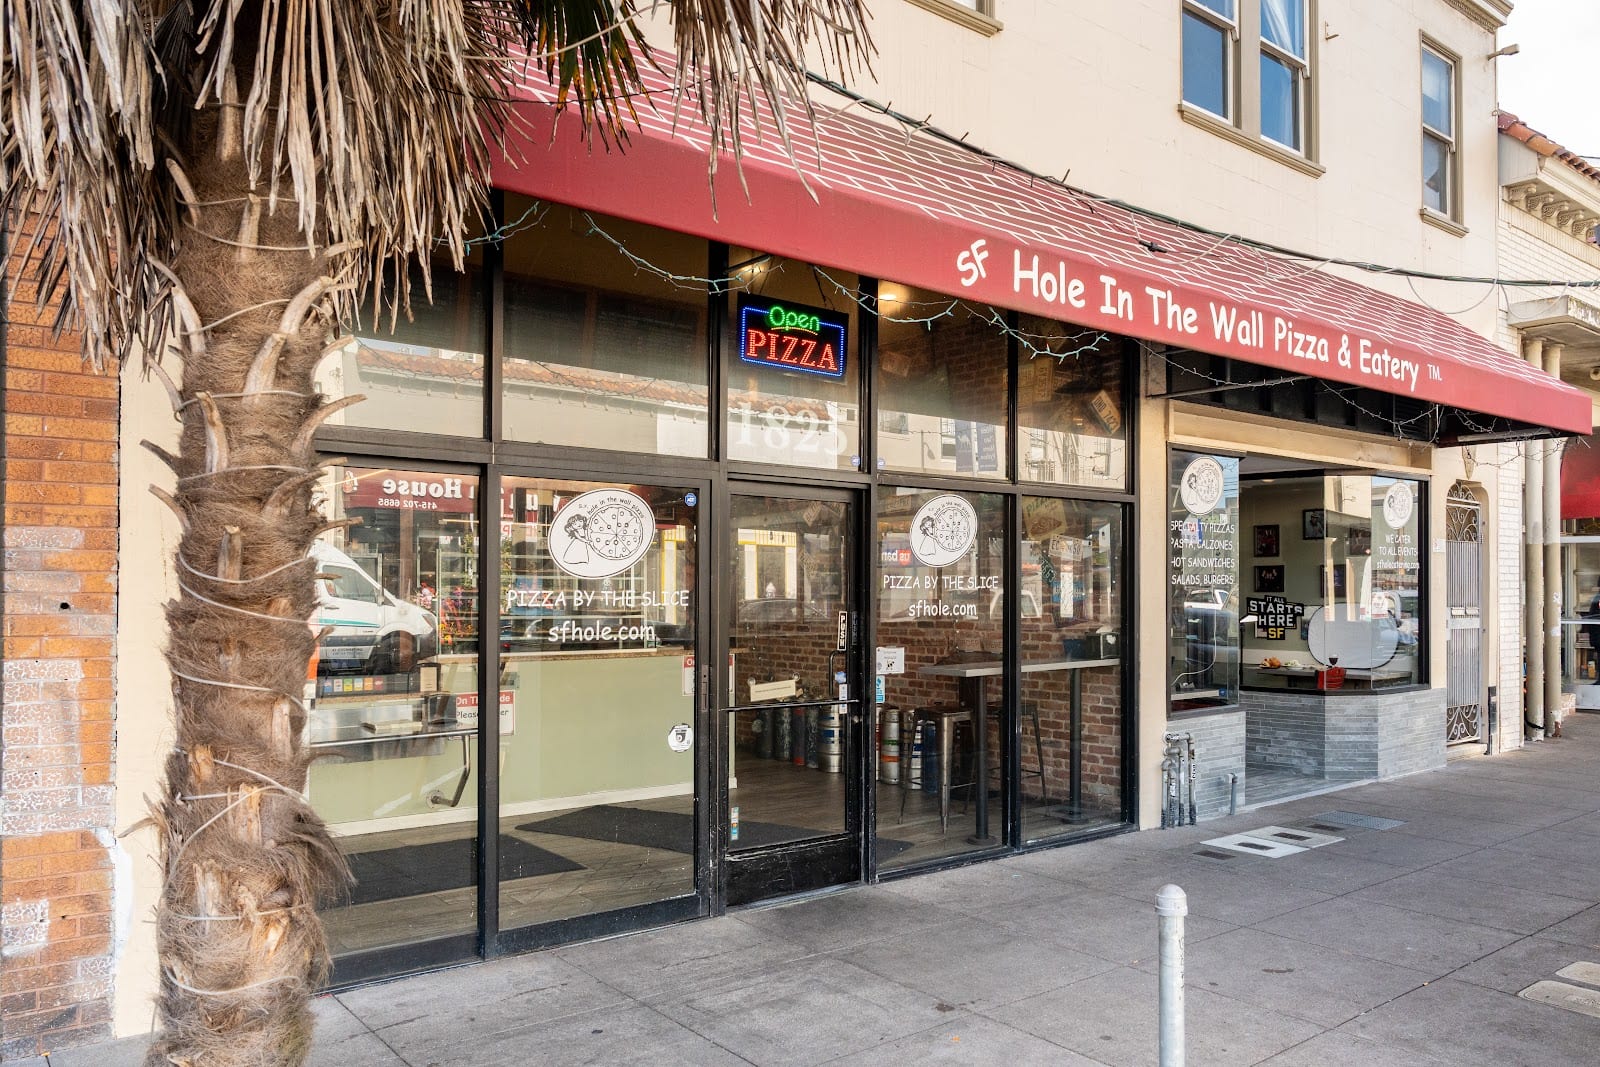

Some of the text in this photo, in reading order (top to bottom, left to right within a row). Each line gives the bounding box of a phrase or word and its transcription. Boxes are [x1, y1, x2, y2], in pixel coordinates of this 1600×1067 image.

[769, 306, 821, 331] Open
[956, 238, 989, 287] SF
[1013, 249, 1085, 308] Hole
[1099, 274, 1134, 321] In
[1145, 285, 1198, 334] The
[1210, 302, 1264, 348] Wall
[1274, 316, 1330, 363] Pizza
[1337, 341, 1352, 368] &
[1359, 339, 1419, 392] Eatery
[746, 329, 838, 371] PIZZA
[1210, 523, 1235, 534] PIZZAS
[1379, 546, 1387, 556] TO
[1171, 557, 1235, 568] HOT SANDWICHES
[883, 575, 999, 589] PIZZA BY THE SLICE
[1171, 574, 1234, 586] SALADS, BURGERS
[507, 589, 690, 607] PIZZA BY THE SLICE
[908, 600, 977, 617] sfhole.com
[1249, 600, 1303, 614] STARTS
[1259, 613, 1294, 626] HERE
[548, 620, 657, 643] sfhole.com
[1268, 627, 1285, 639] SF
[456, 696, 468, 705] On
